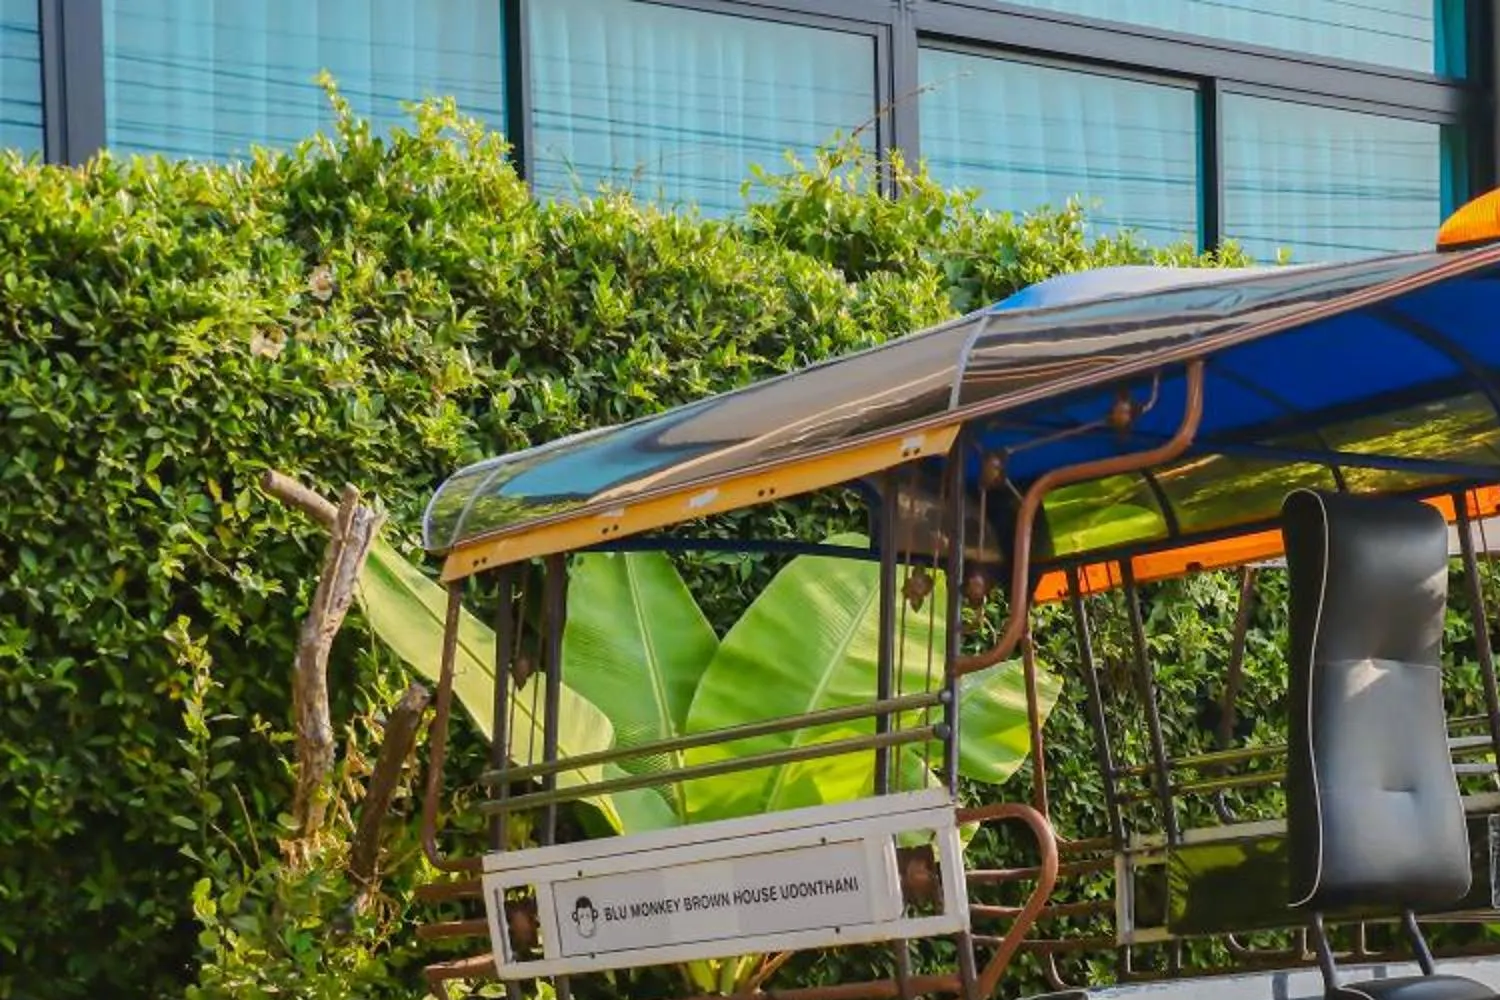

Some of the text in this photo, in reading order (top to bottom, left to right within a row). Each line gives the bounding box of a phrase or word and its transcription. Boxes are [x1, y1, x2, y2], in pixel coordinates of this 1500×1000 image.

[604, 877, 859, 921] BLU MONKEY BROWN HOUSE UDONTHANI
